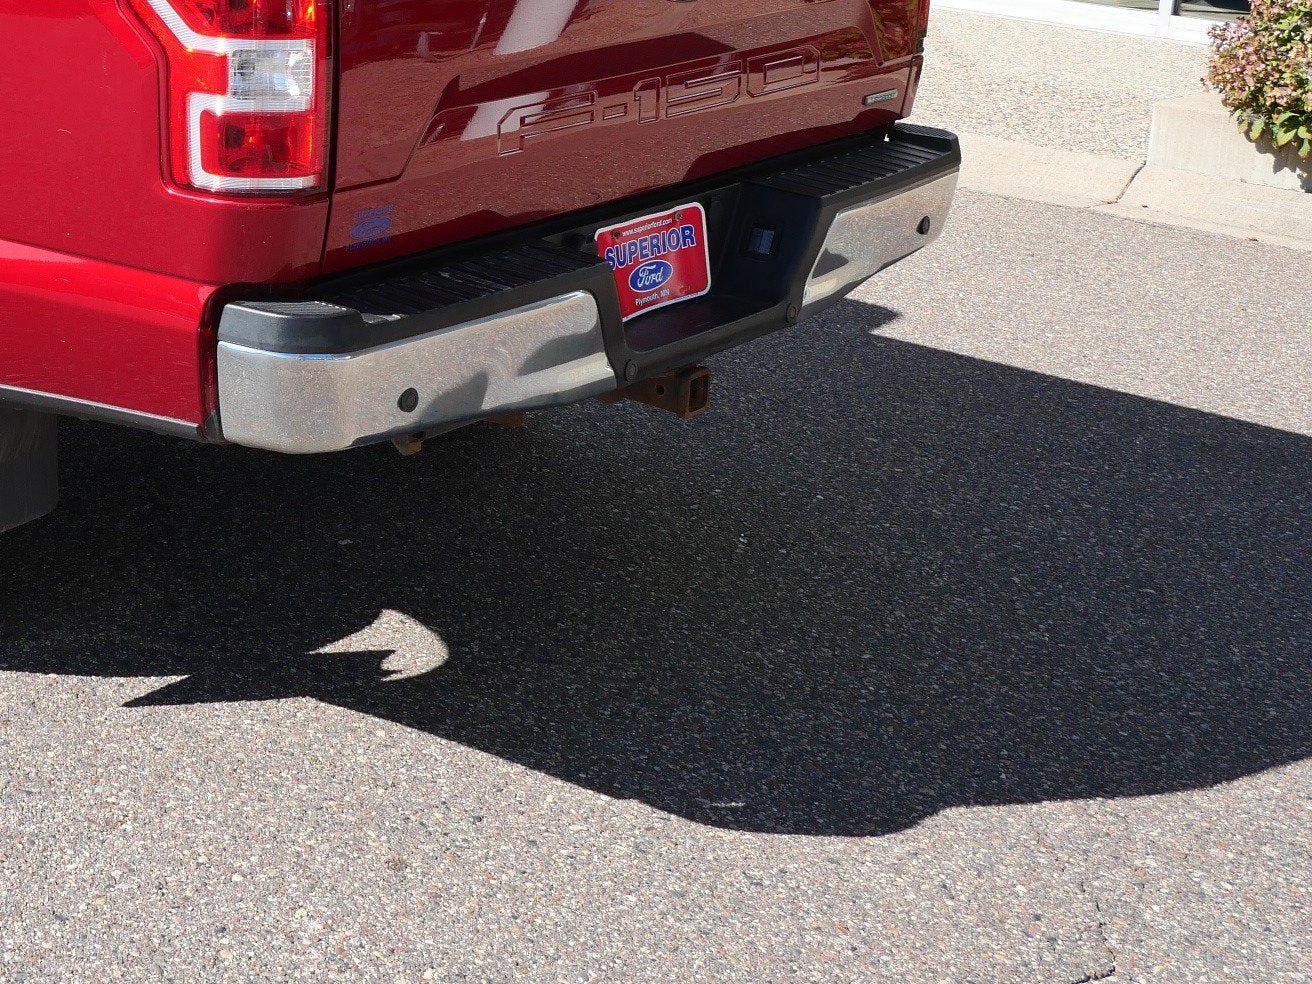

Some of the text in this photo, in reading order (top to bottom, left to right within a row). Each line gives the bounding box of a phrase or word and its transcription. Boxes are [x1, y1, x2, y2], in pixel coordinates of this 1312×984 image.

[497, 44, 821, 156] F-150
[621, 218, 673, 237] www.superiorford.com
[605, 224, 696, 270] SUPERIOR
[637, 263, 664, 288] Ford
